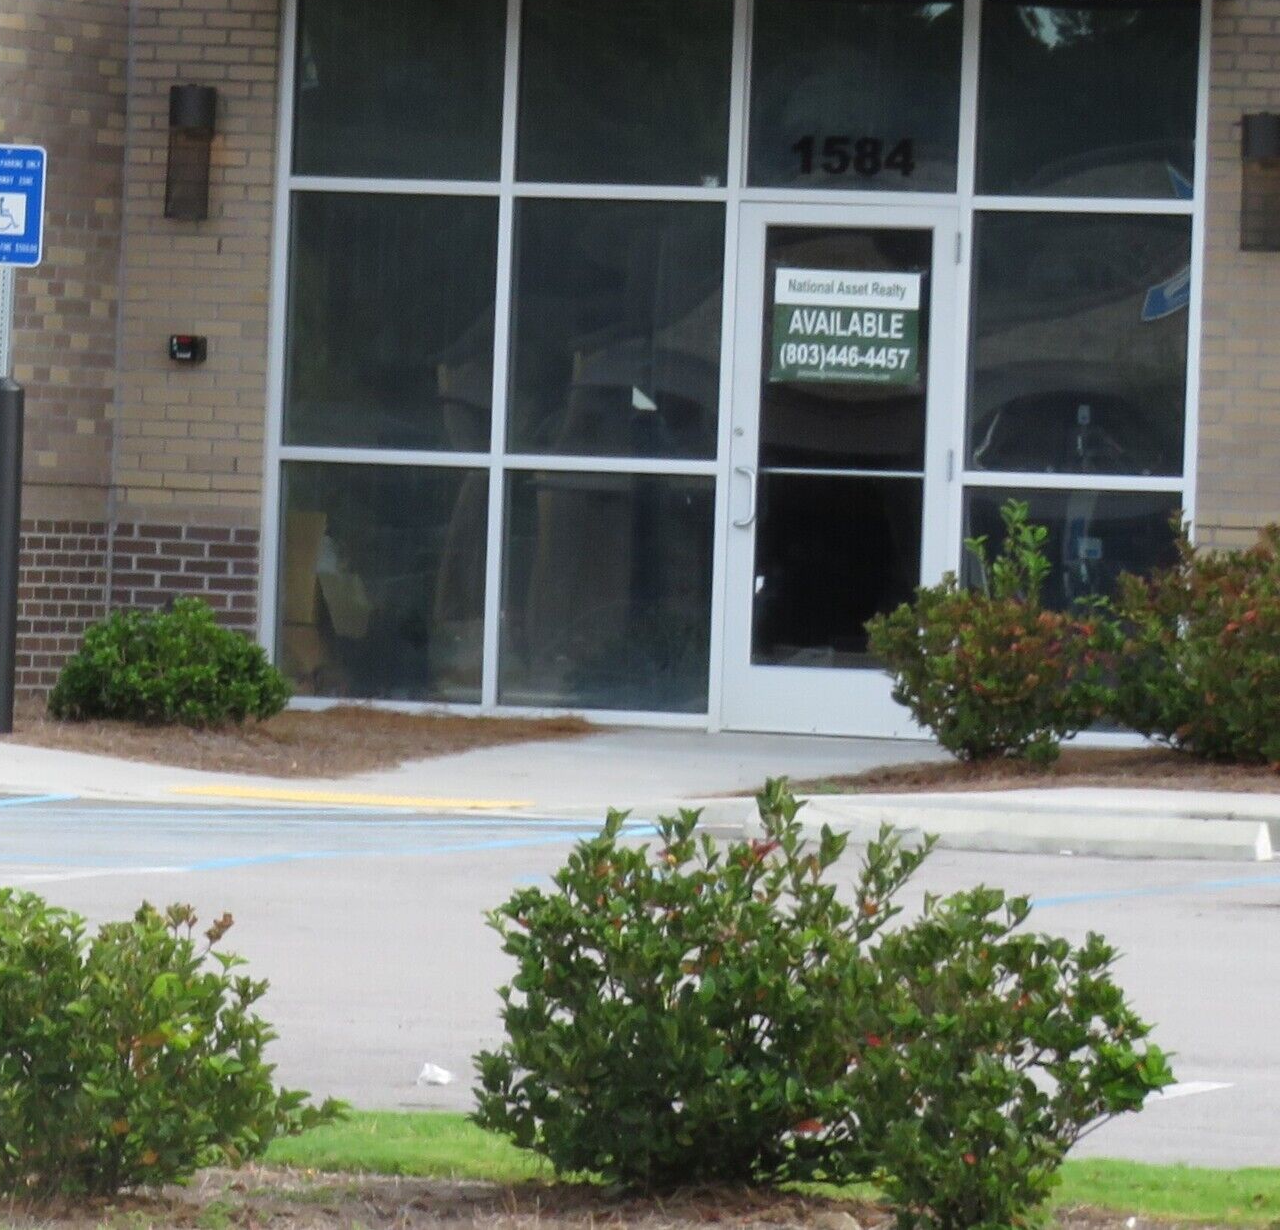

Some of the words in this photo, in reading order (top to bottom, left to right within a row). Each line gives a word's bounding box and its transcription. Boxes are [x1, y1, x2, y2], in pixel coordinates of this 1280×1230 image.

[792, 135, 916, 176] 1584
[788, 278, 835, 294] National
[837, 280, 868, 296] Asset
[871, 281, 907, 301] Realty
[788, 309, 904, 340] AVAILABLE
[779, 343, 911, 370] (803)446-4457
